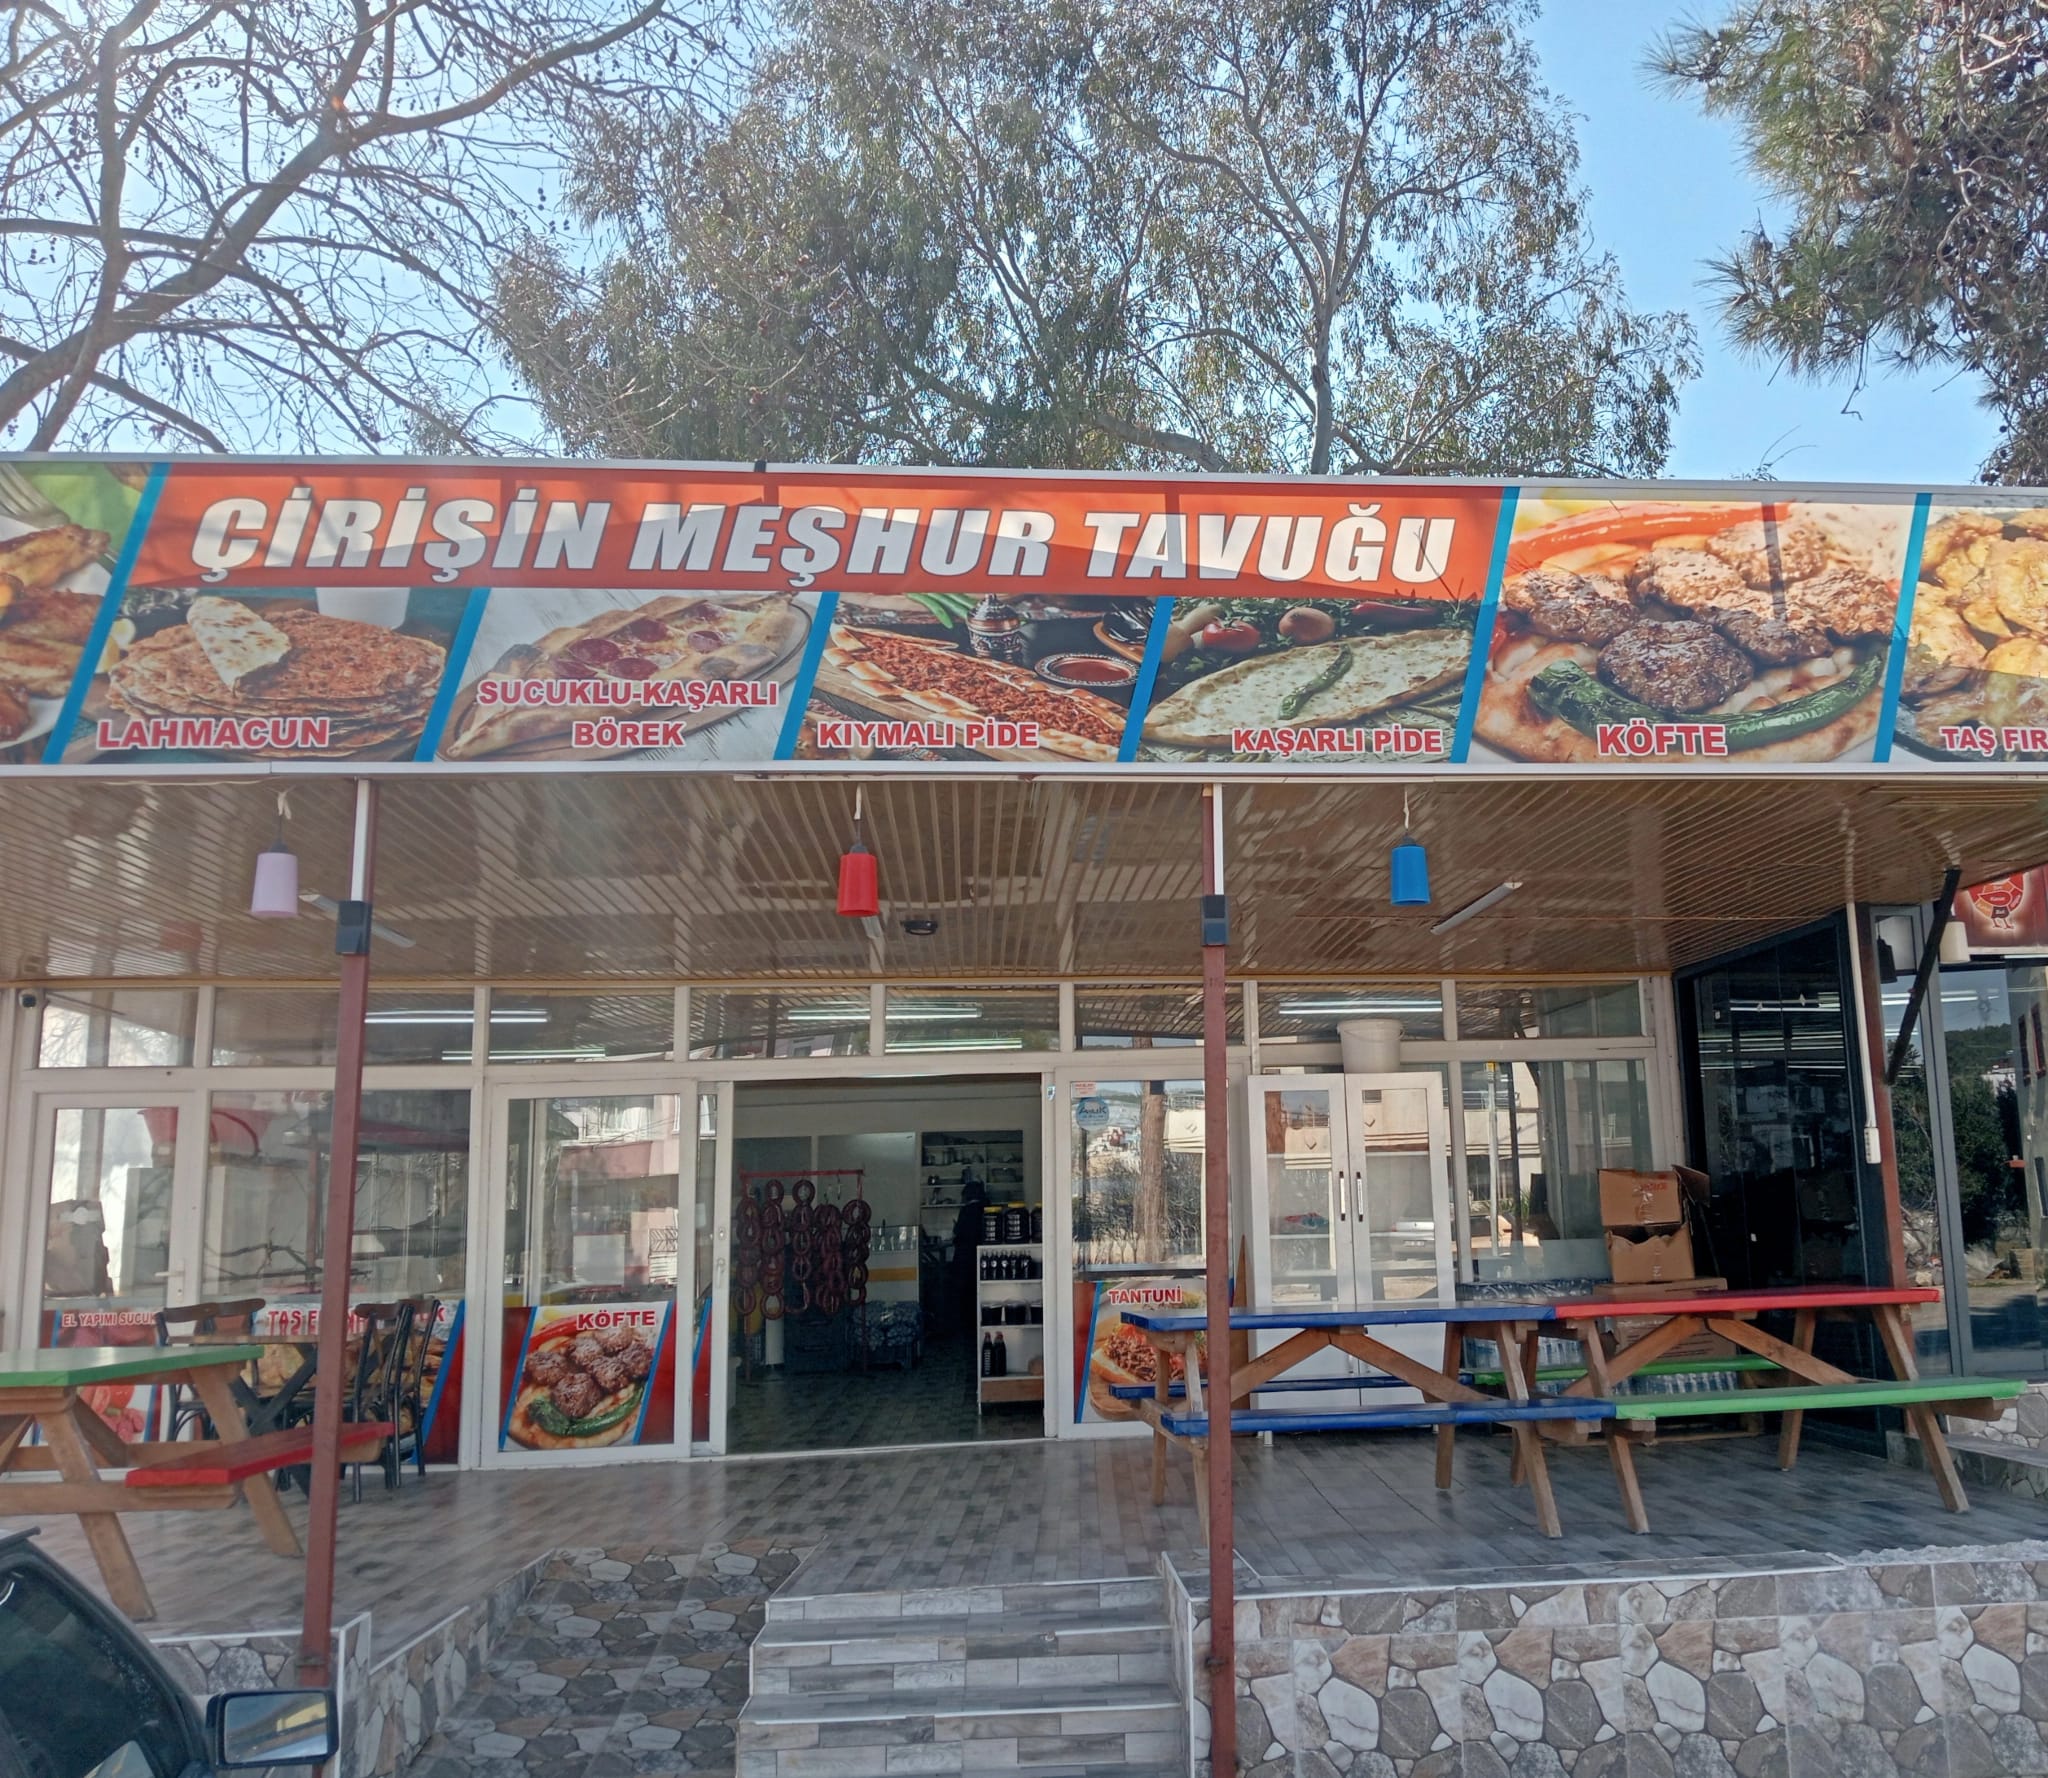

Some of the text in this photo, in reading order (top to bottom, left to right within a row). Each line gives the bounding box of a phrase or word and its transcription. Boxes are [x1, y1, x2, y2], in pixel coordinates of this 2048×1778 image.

[191, 486, 1457, 588] ÇİRİŞİN MEŞHUR TAVUĞU
[475, 679, 780, 711] SUCUKLU-KAŞARLI
[99, 717, 330, 750] LAHMACUN
[571, 716, 686, 747] BÖREK
[816, 715, 1039, 749] KIYMALI PİDE
[1231, 721, 1443, 758] KAŞARLI PİDE
[1597, 718, 1728, 756] KÖFTE
[1939, 726, 1997, 756] TAŞ
[1108, 1285, 1183, 1304] TANTUNİ
[62, 1313, 77, 1328] EL
[79, 1312, 116, 1327] YAPIMI
[576, 1309, 656, 1330] KÖFTE
